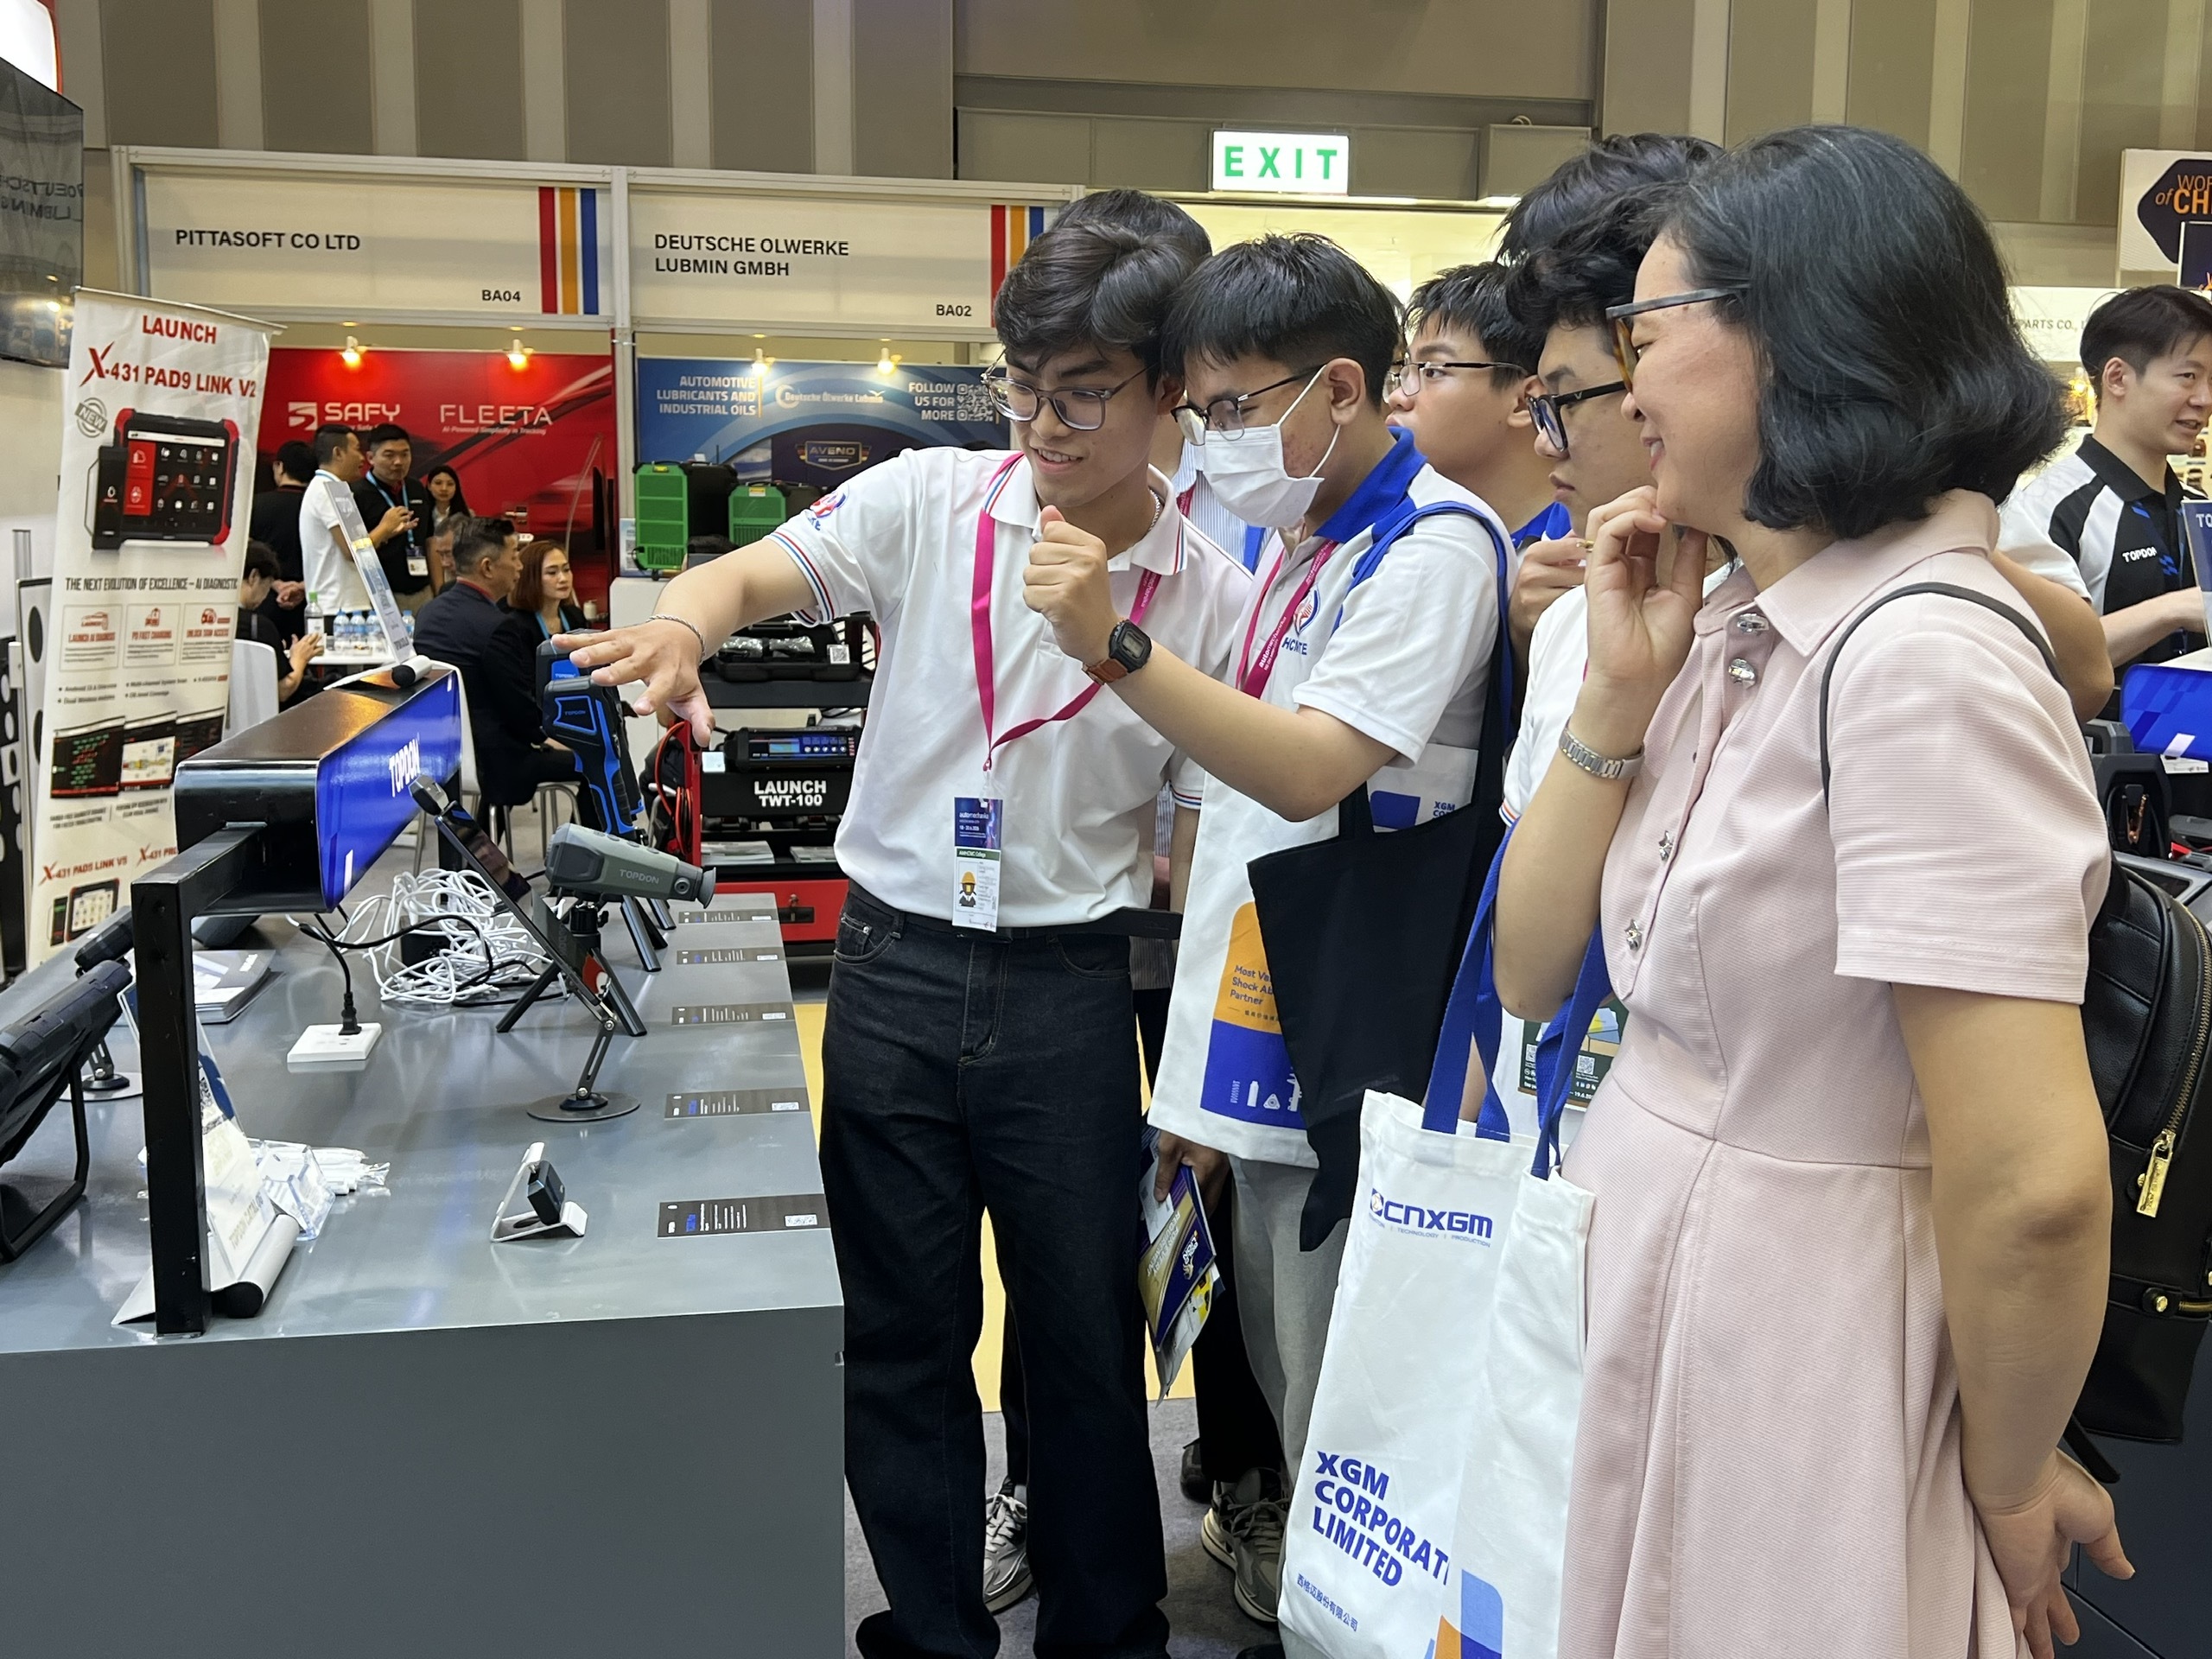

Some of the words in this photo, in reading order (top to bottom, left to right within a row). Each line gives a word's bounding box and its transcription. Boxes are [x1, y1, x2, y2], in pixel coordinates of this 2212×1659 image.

[1224, 145, 1338, 180] EXIT
[2155, 188, 2174, 206] of
[175, 229, 284, 248] PITTASOFT
[291, 232, 320, 249] CO
[325, 234, 360, 251] LTD
[654, 234, 755, 253] DEUTSCHE
[760, 238, 849, 256] OLWERKE
[655, 257, 728, 275] LUBMIN
[734, 260, 790, 276] GMBH
[481, 289, 521, 302] BA04
[936, 303, 972, 317] BA02
[143, 315, 217, 344] LAUNCH
[144, 366, 191, 390] PAD9
[195, 373, 232, 395] LINK
[238, 378, 257, 397] V2
[679, 375, 756, 388] AUTOMOTIVE
[908, 382, 955, 394] FOLLOW
[656, 390, 727, 402] LUBRICANTS
[730, 391, 756, 403] AND
[914, 396, 931, 407] US
[935, 396, 955, 408] FOR
[324, 402, 401, 422] SAFY
[440, 404, 553, 426] FLEETA
[659, 403, 728, 415] INDUSTRIAL
[731, 403, 756, 416] OILS
[921, 409, 955, 422] MORE
[79, 408, 107, 429] NEW
[810, 447, 855, 455] AVENO
[66, 577, 82, 591] THE
[84, 577, 103, 591] NEXT
[104, 577, 137, 591] EVOLUTION
[138, 577, 149, 591] OF
[149, 577, 188, 590] EXCELLENCE
[390, 738, 421, 798] TOPDON
[753, 780, 827, 796] LAUNCH
[759, 794, 823, 807] TWT-100
[1433, 801, 1455, 811] XGM
[95, 859, 114, 871] LINK
[619, 868, 660, 885] TOPDON
[1234, 964, 1256, 978] Most
[1258, 970, 1271, 982] Va
[1232, 976, 1259, 992] Shock
[1230, 988, 1264, 1005] Partner
[1451, 1235, 1491, 1248] PRODUCTION
[1315, 1451, 1389, 1501] XGM
[1313, 1505, 1403, 1586] LIMITED
